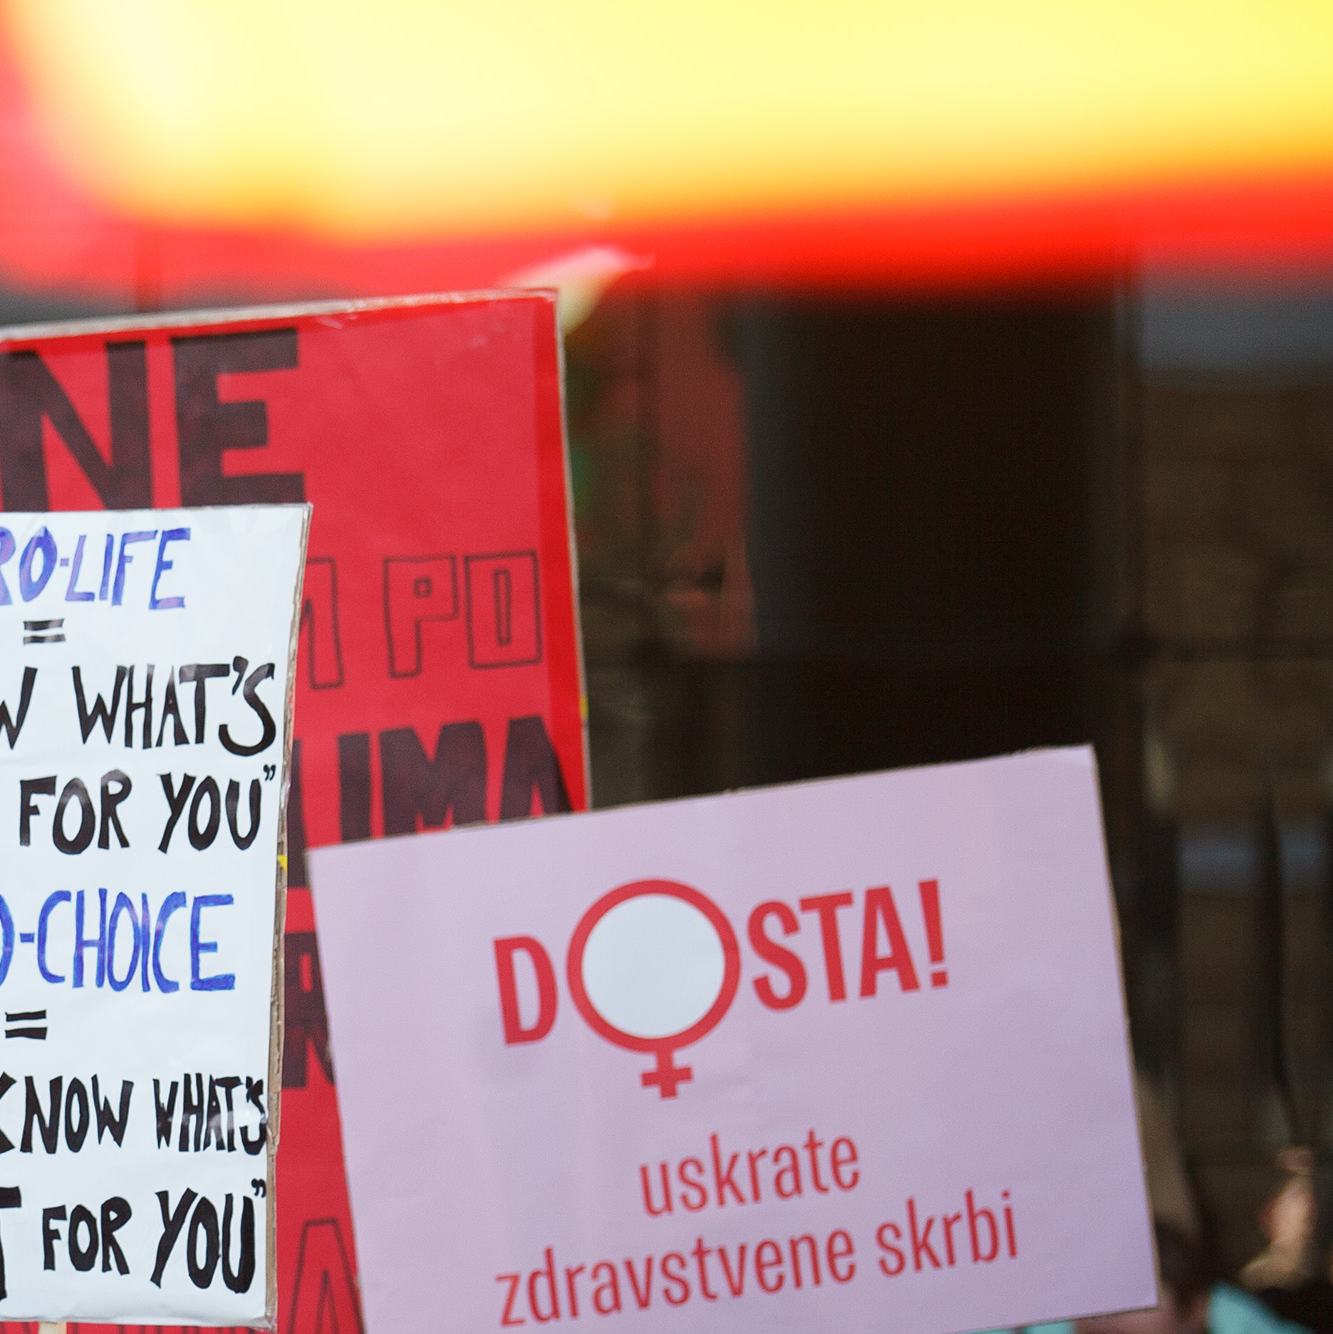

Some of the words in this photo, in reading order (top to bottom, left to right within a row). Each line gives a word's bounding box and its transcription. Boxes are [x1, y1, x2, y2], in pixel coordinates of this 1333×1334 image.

[71, 656, 277, 757] WHAT'S
[19, 769, 133, 855] FOR
[493, 876, 950, 1101] DOSTA!
[152, 1073, 268, 1156] WHAT'S
[639, 1127, 861, 1218] uskrate
[42, 1196, 133, 1276] FOR
[494, 1234, 858, 1330] zdravstvene
[875, 1189, 1020, 1280] skrbi
